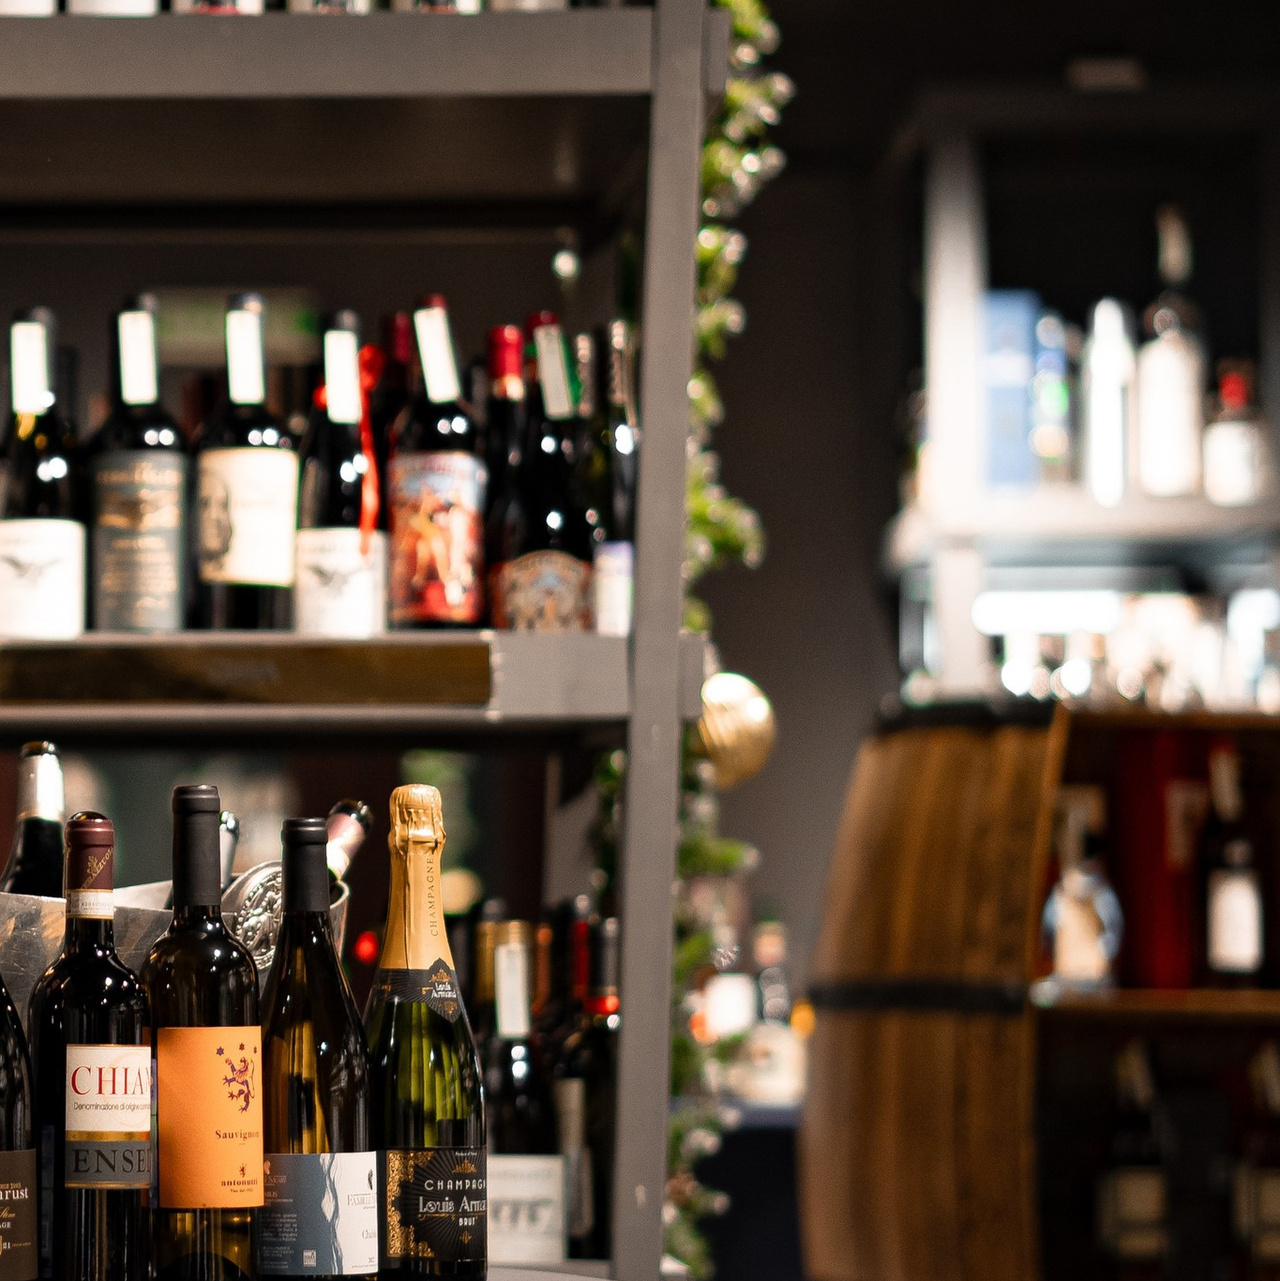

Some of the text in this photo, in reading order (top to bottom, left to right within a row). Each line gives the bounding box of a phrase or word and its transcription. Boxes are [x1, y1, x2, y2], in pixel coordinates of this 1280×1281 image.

[426, 857, 439, 937] CHAMPAGNE
[73, 1101, 119, 1111] Denominazione
[215, 1129, 259, 1141] Sauvignon
[221, 1178, 258, 1187] antonutti
[419, 1196, 455, 1213] Louis
[458, 1195, 487, 1213] Arma
[459, 1217, 476, 1227] BRUT
[2, 1241, 11, 1250] 21
